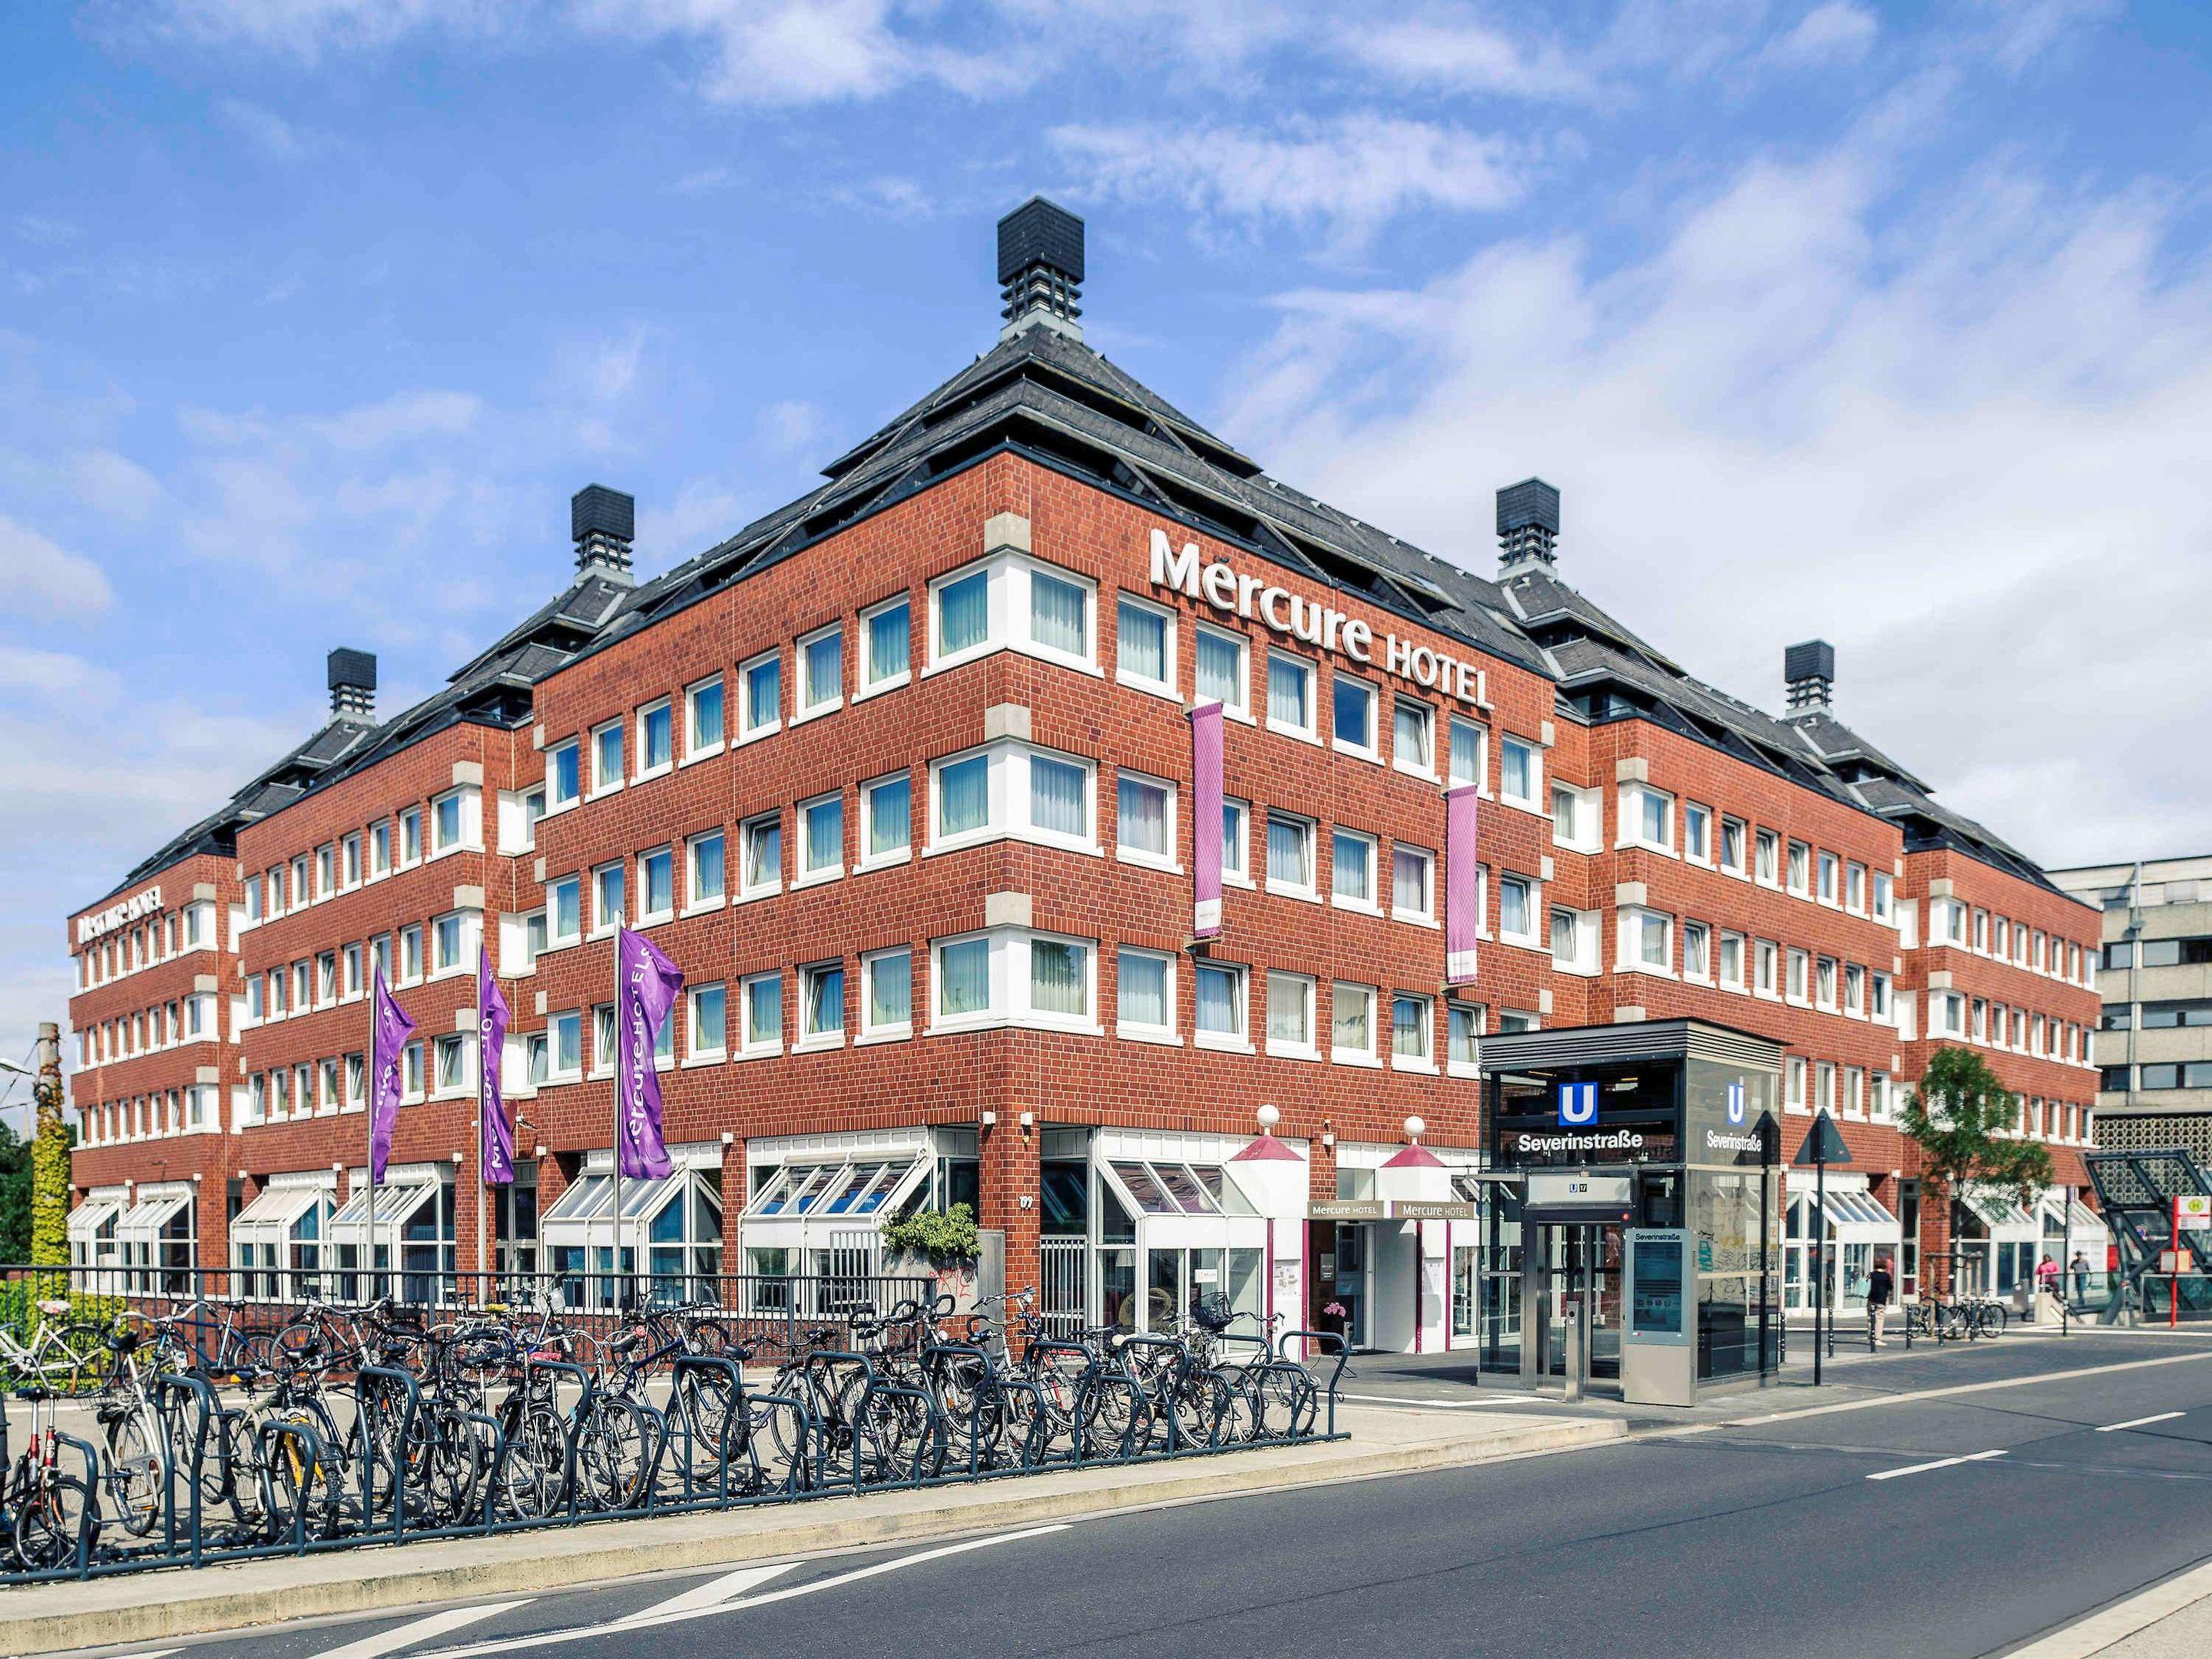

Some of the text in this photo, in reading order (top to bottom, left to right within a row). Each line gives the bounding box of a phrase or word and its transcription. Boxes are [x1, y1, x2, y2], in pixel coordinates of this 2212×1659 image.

[1150, 528, 1495, 710] Mercure HOTEL
[630, 1041, 644, 1144] ercure
[1561, 1084, 1594, 1123] U
[1728, 1084, 1744, 1124] U
[1518, 1130, 1643, 1152] Severinstraße
[1707, 1130, 1762, 1152] Severinstraße
[1570, 1184, 1578, 1192] U
[1313, 1205, 1350, 1215] Mercure
[1402, 1204, 1468, 1217] Mercure HOTEL
